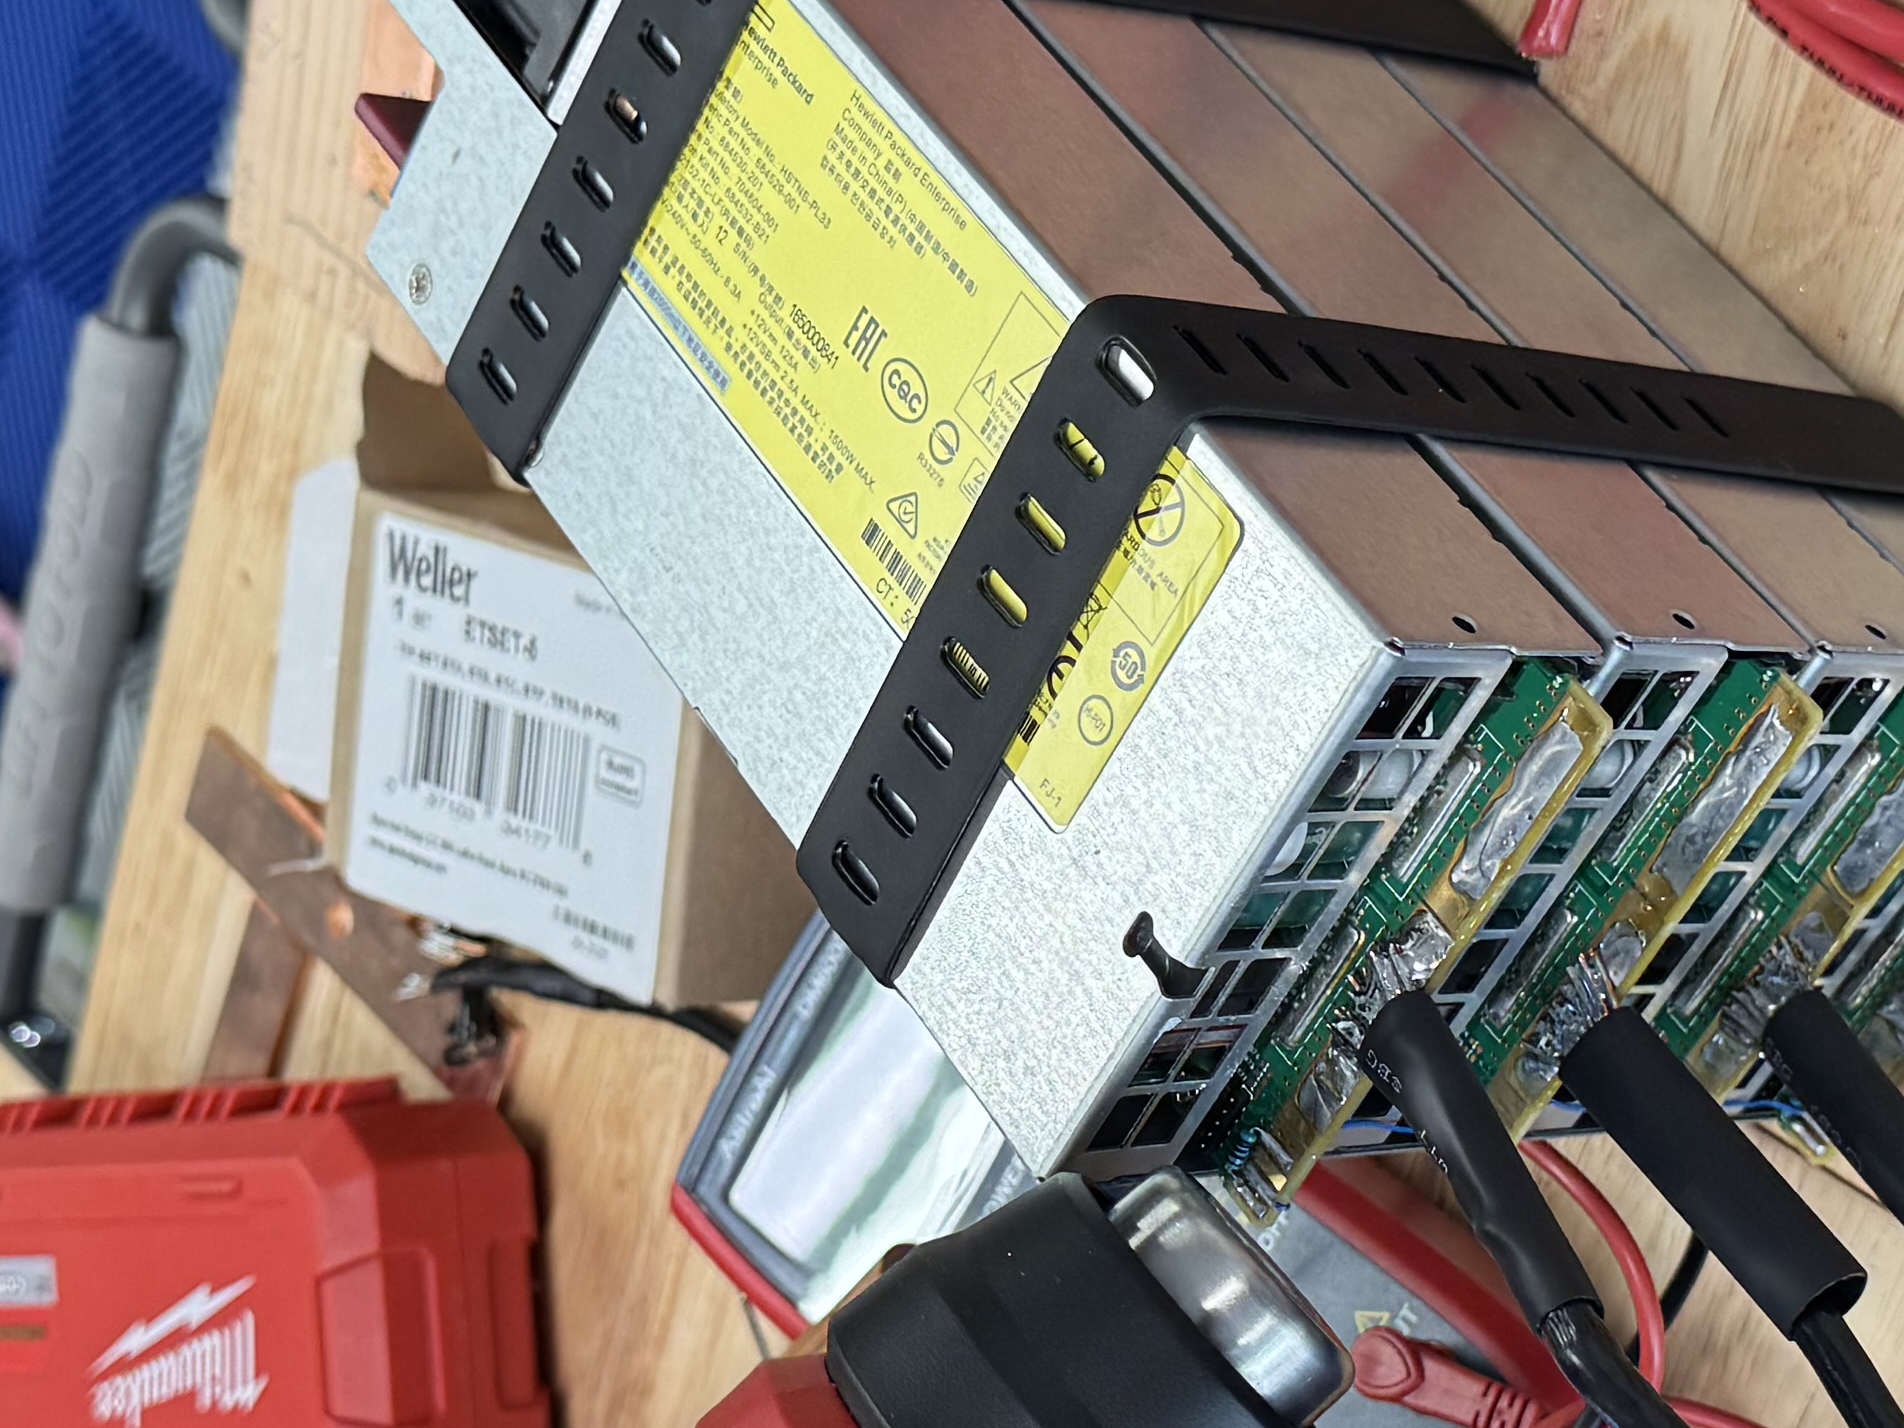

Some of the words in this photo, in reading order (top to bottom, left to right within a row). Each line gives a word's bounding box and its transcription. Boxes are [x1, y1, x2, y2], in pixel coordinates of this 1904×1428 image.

[775, 56, 814, 106] Packard
[739, 116, 765, 150] Model
[840, 107, 881, 161] Company
[833, 122, 858, 156] Made
[858, 151, 868, 166] in
[866, 160, 906, 214] China(P)
[849, 89, 884, 135] Hewlett
[883, 128, 920, 178] Packard
[919, 172, 966, 233] Enterprise
[714, 224, 729, 246] 12
[778, 343, 800, 373] 125A
[787, 302, 839, 369] 1650000841
[781, 370, 800, 397] 2.5A
[827, 428, 856, 466] 1500W
[384, 528, 478, 608] Weller
[1158, 569, 1179, 598] AREA
[392, 595, 405, 621] 1
[1039, 777, 1061, 808] FJ-1
